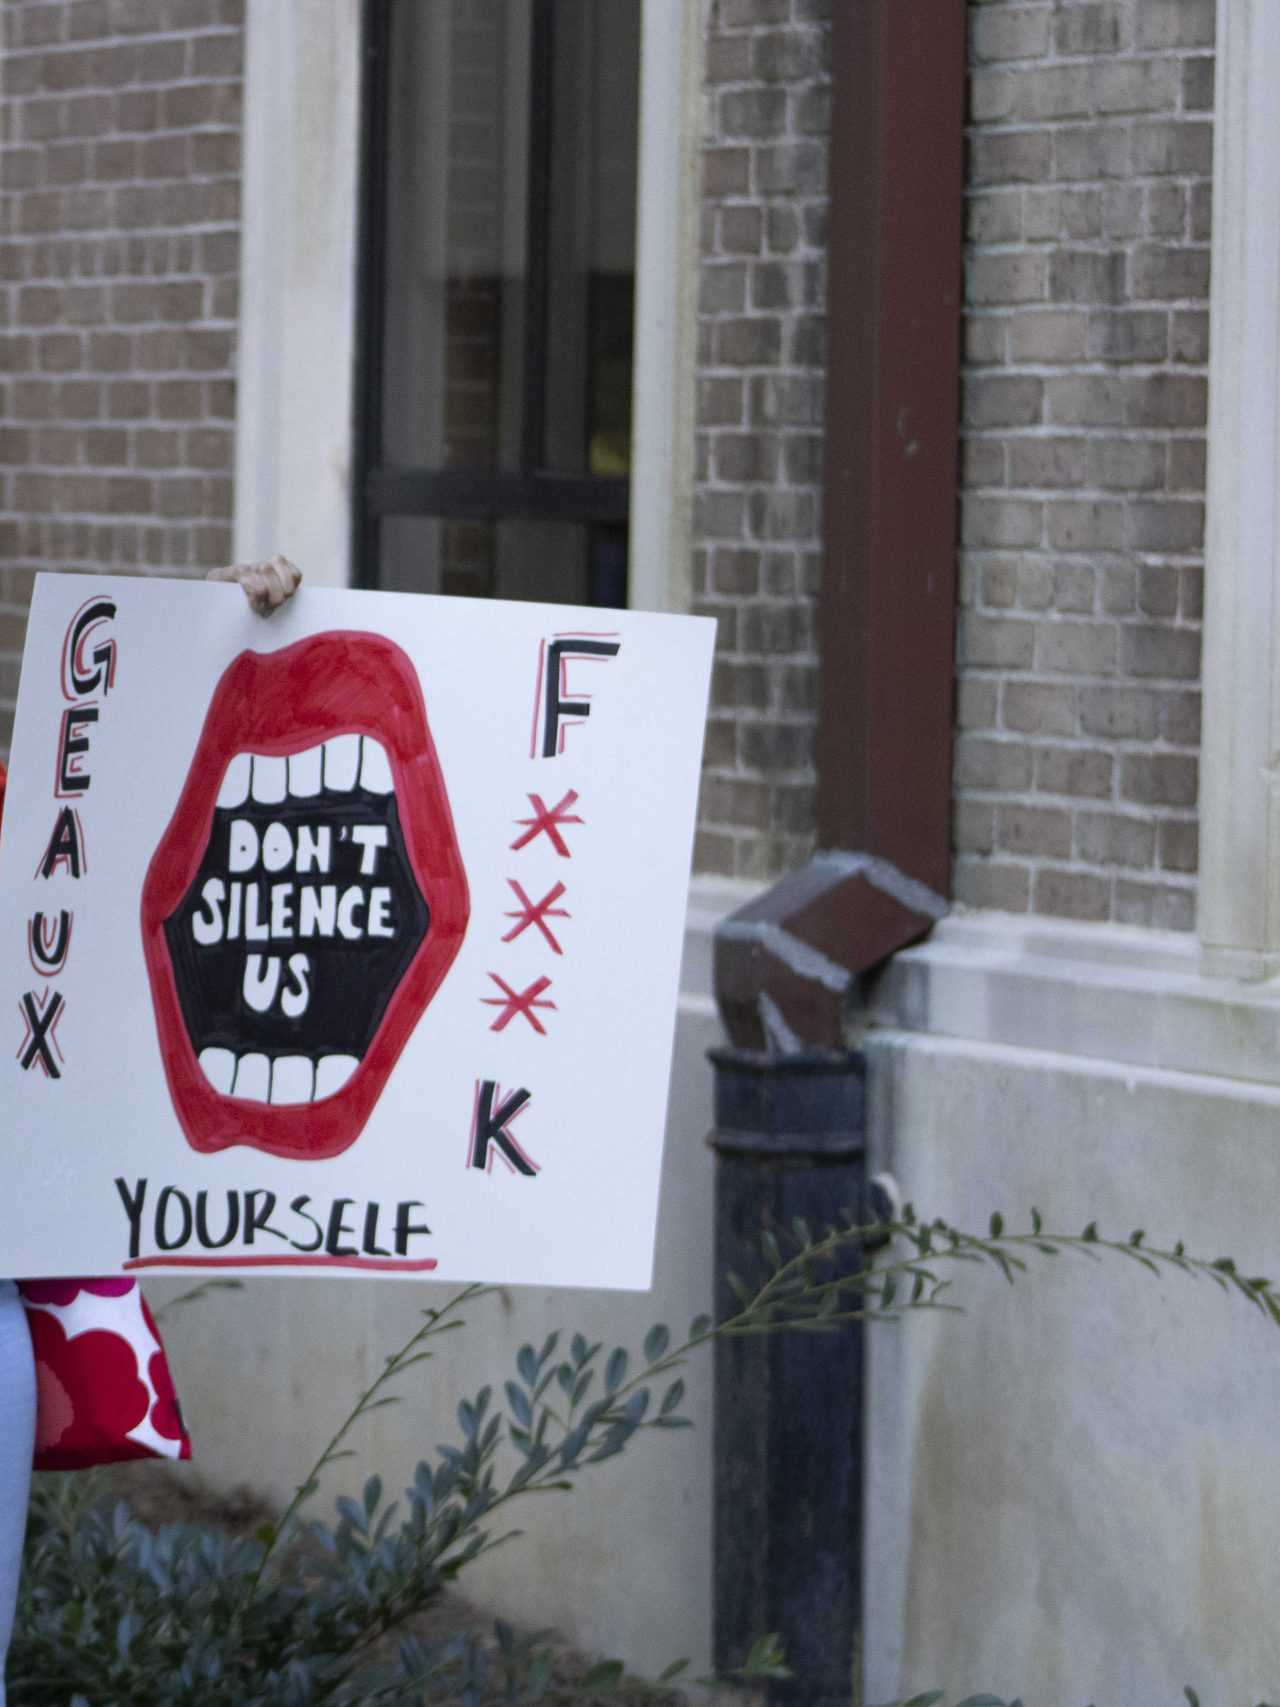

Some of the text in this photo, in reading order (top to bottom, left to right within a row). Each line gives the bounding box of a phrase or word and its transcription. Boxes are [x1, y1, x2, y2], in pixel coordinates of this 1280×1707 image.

[17, 596, 117, 1080] GEAUX
[227, 821, 388, 875] DON'T
[192, 879, 395, 945] SILENCE
[242, 953, 311, 1018] US
[114, 1177, 433, 1260] YOURSELF
